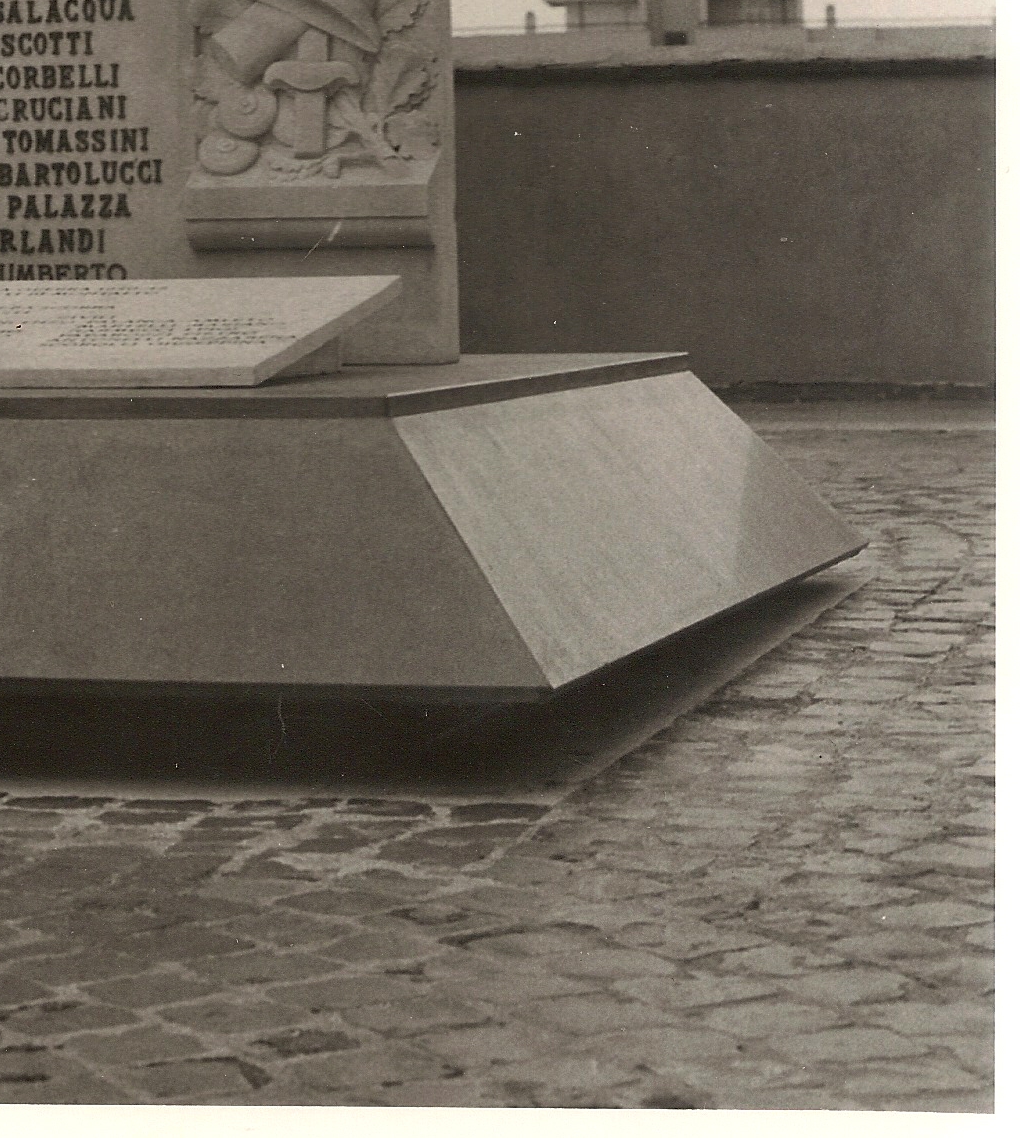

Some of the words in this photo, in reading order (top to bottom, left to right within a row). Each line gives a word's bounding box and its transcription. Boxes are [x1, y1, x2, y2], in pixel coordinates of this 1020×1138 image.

[1, 31, 93, 58] SCOTTI
[2, 127, 149, 154] TOMASSINI
[8, 194, 131, 219] PALAZZA
[0, 264, 127, 281] UMBERTO
